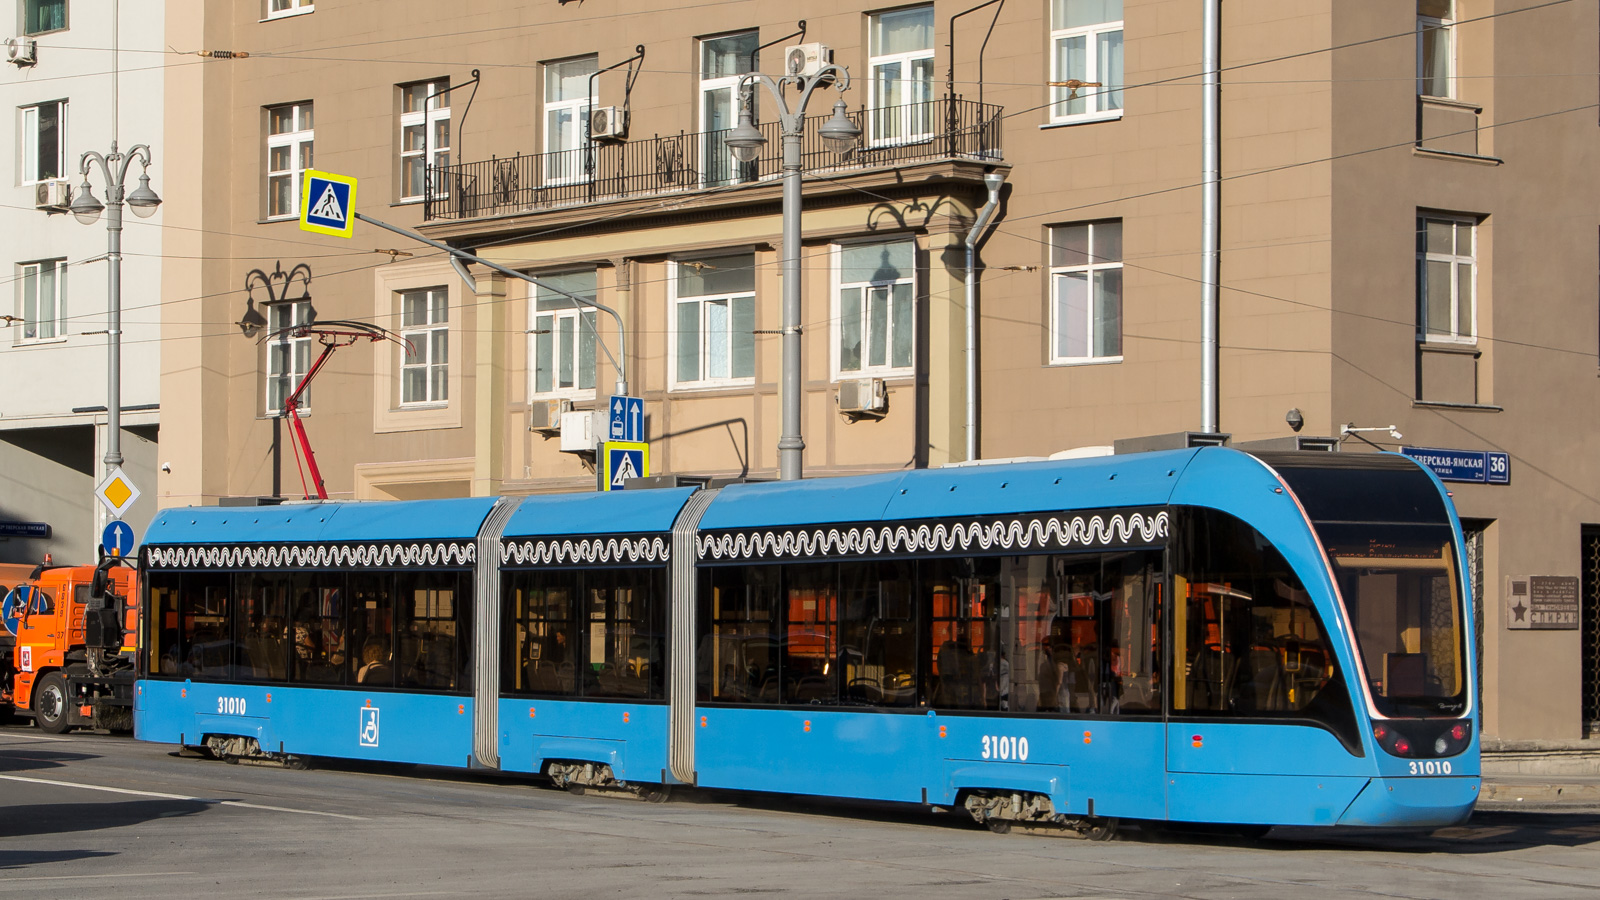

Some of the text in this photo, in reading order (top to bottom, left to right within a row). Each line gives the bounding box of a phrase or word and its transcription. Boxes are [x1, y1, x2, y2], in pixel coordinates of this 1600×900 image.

[1490, 456, 1506, 472] 36
[217, 696, 247, 715] 31010
[981, 734, 1029, 761] 31010
[1408, 760, 1452, 775] 31010
